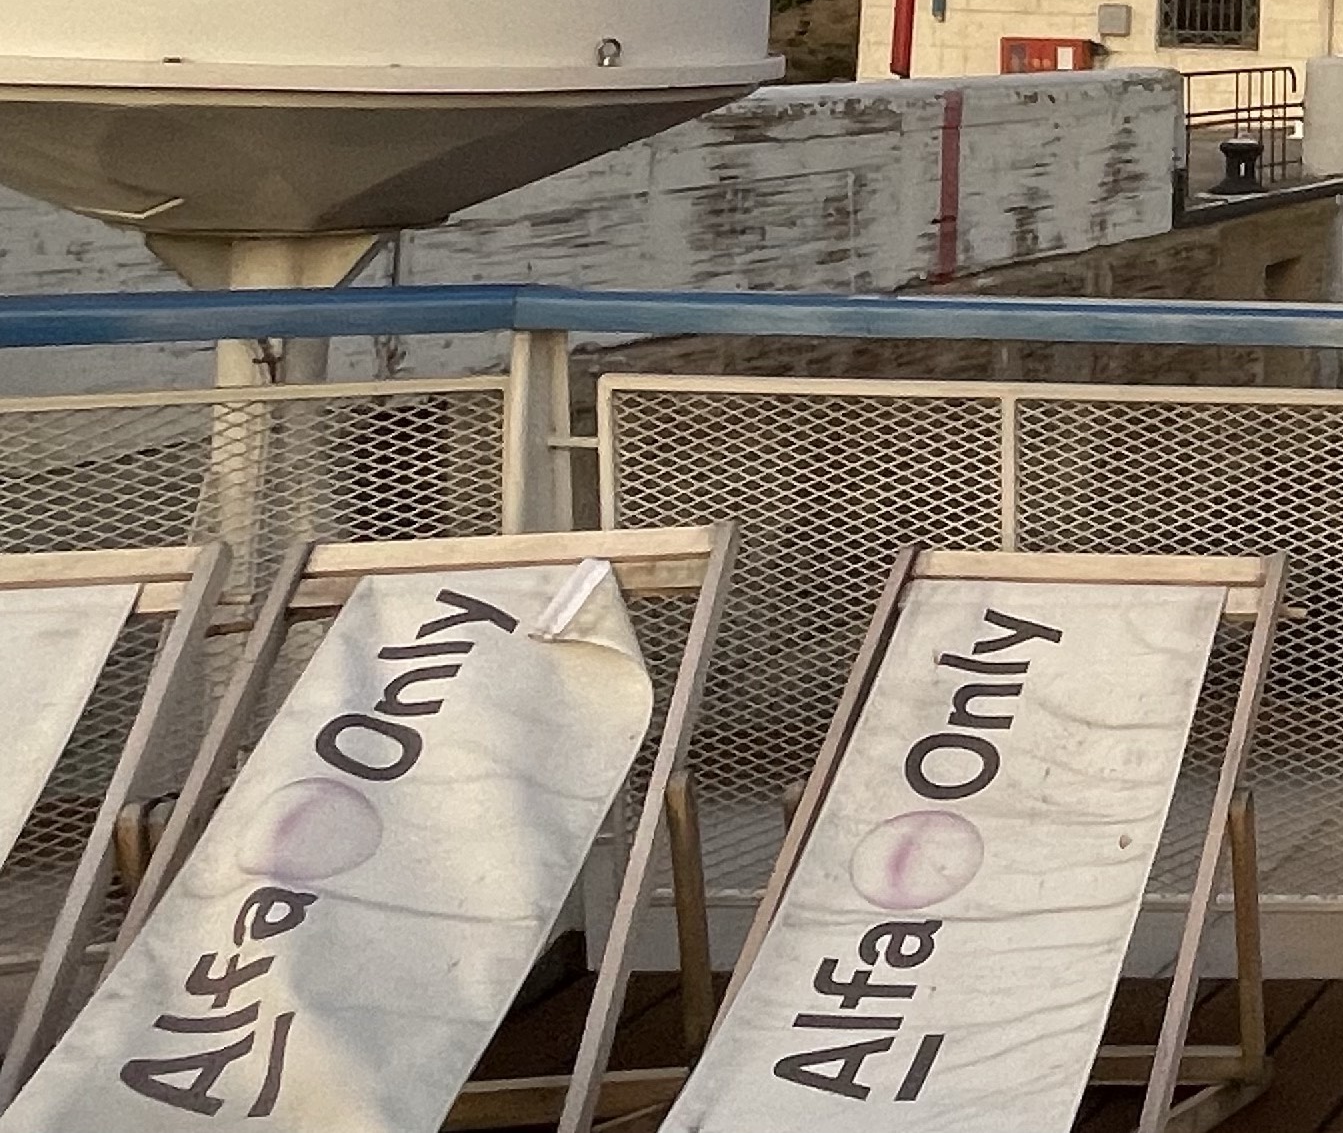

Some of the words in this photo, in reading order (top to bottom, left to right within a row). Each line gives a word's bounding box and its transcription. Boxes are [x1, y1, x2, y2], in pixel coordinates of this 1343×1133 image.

[119, 886, 319, 1117] Alfa
[315, 589, 518, 782] Only
[773, 919, 943, 1102] Alfa
[905, 608, 1063, 800] Only
